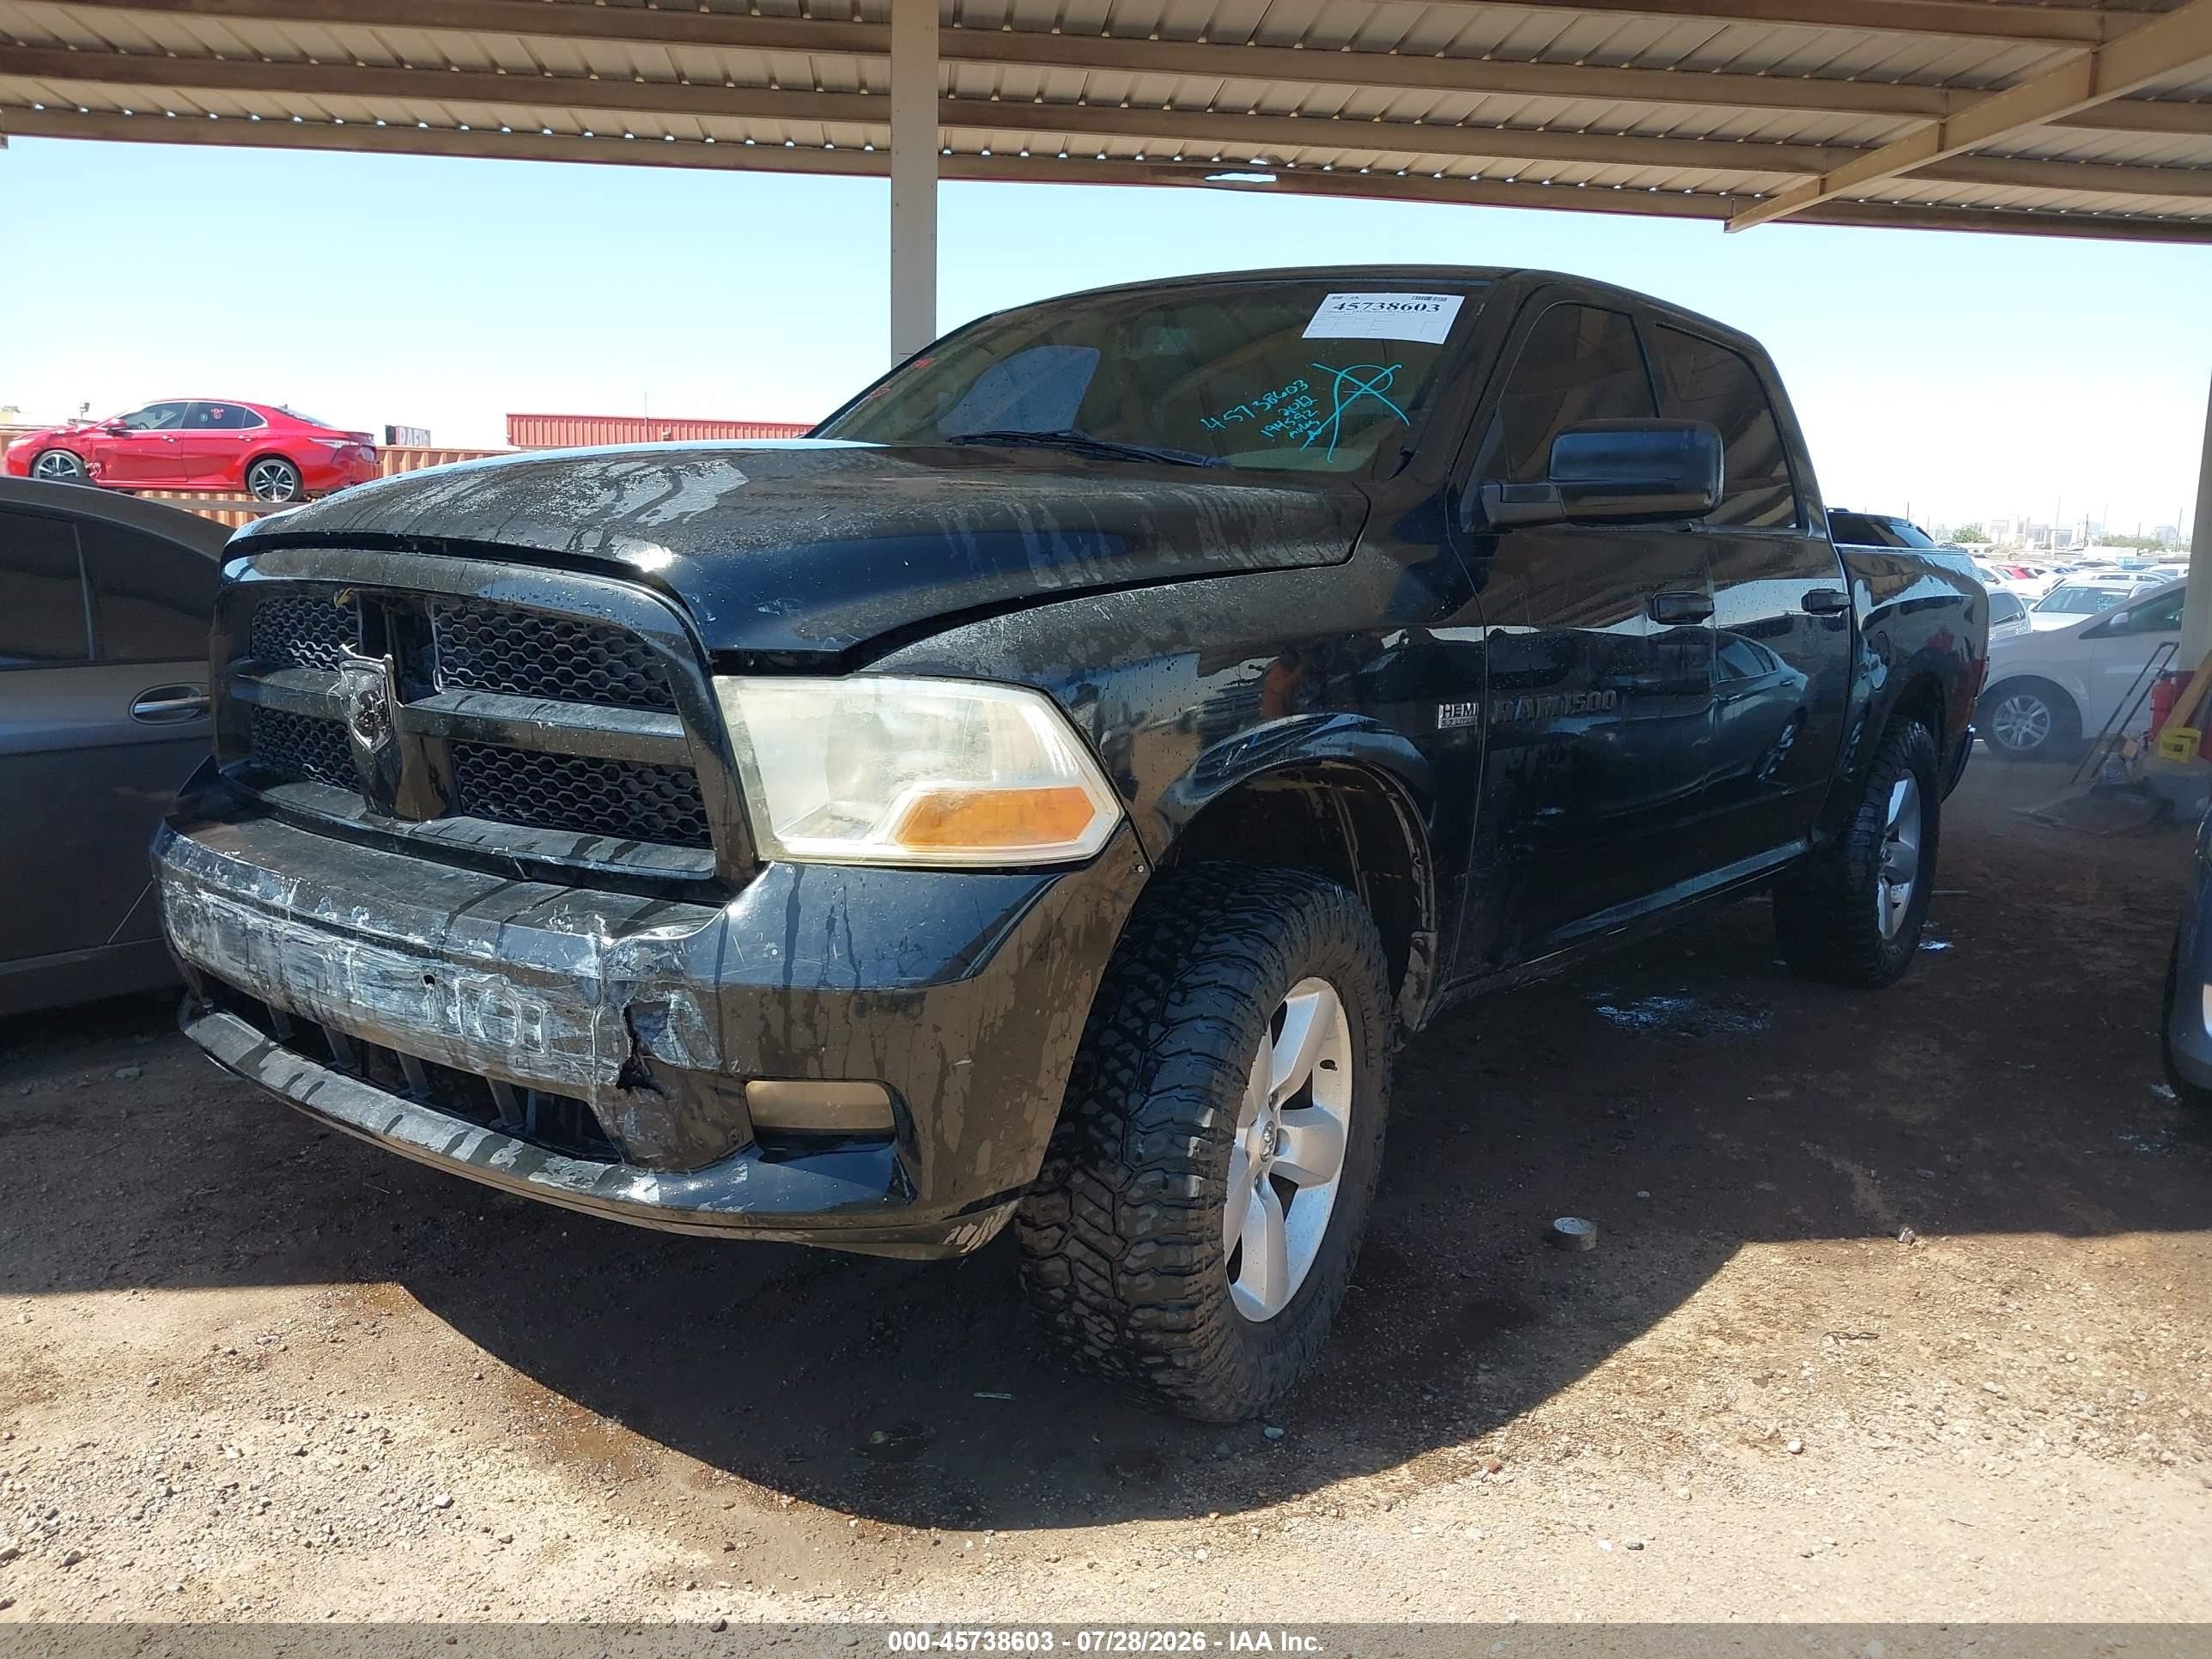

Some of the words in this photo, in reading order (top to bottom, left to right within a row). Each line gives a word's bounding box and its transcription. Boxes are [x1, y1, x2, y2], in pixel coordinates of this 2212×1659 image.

[1332, 301, 1441, 313] 45738603
[1443, 702, 1478, 718] HEMI
[1492, 694, 1560, 724] RAM
[1561, 690, 1617, 715] 1500
